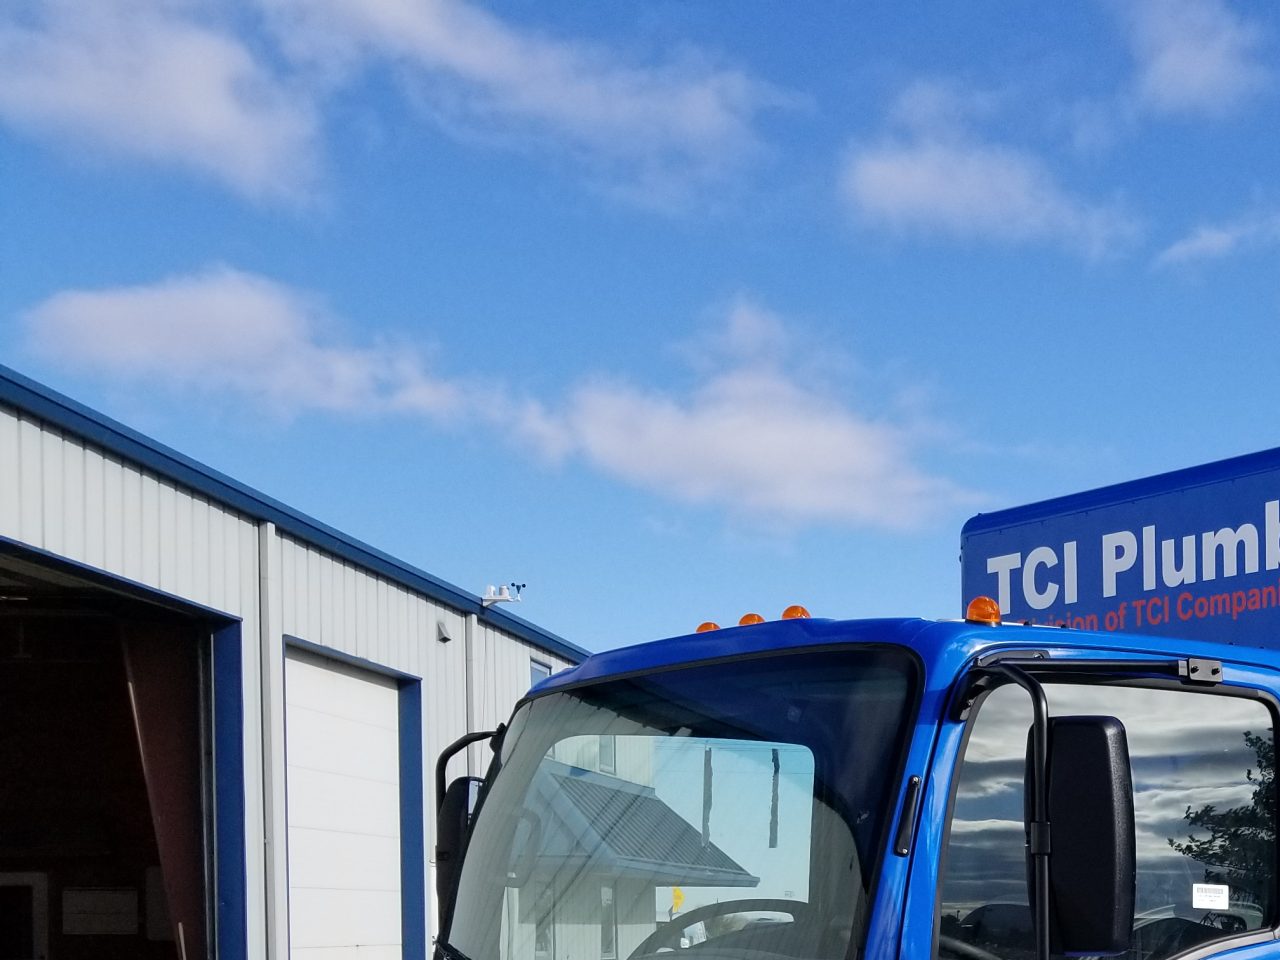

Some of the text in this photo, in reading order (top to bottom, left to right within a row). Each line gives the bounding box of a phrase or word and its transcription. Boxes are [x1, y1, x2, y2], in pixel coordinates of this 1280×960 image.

[987, 542, 1078, 615] TCI
[1105, 602, 1128, 631] of
[1132, 597, 1169, 627] TCI
